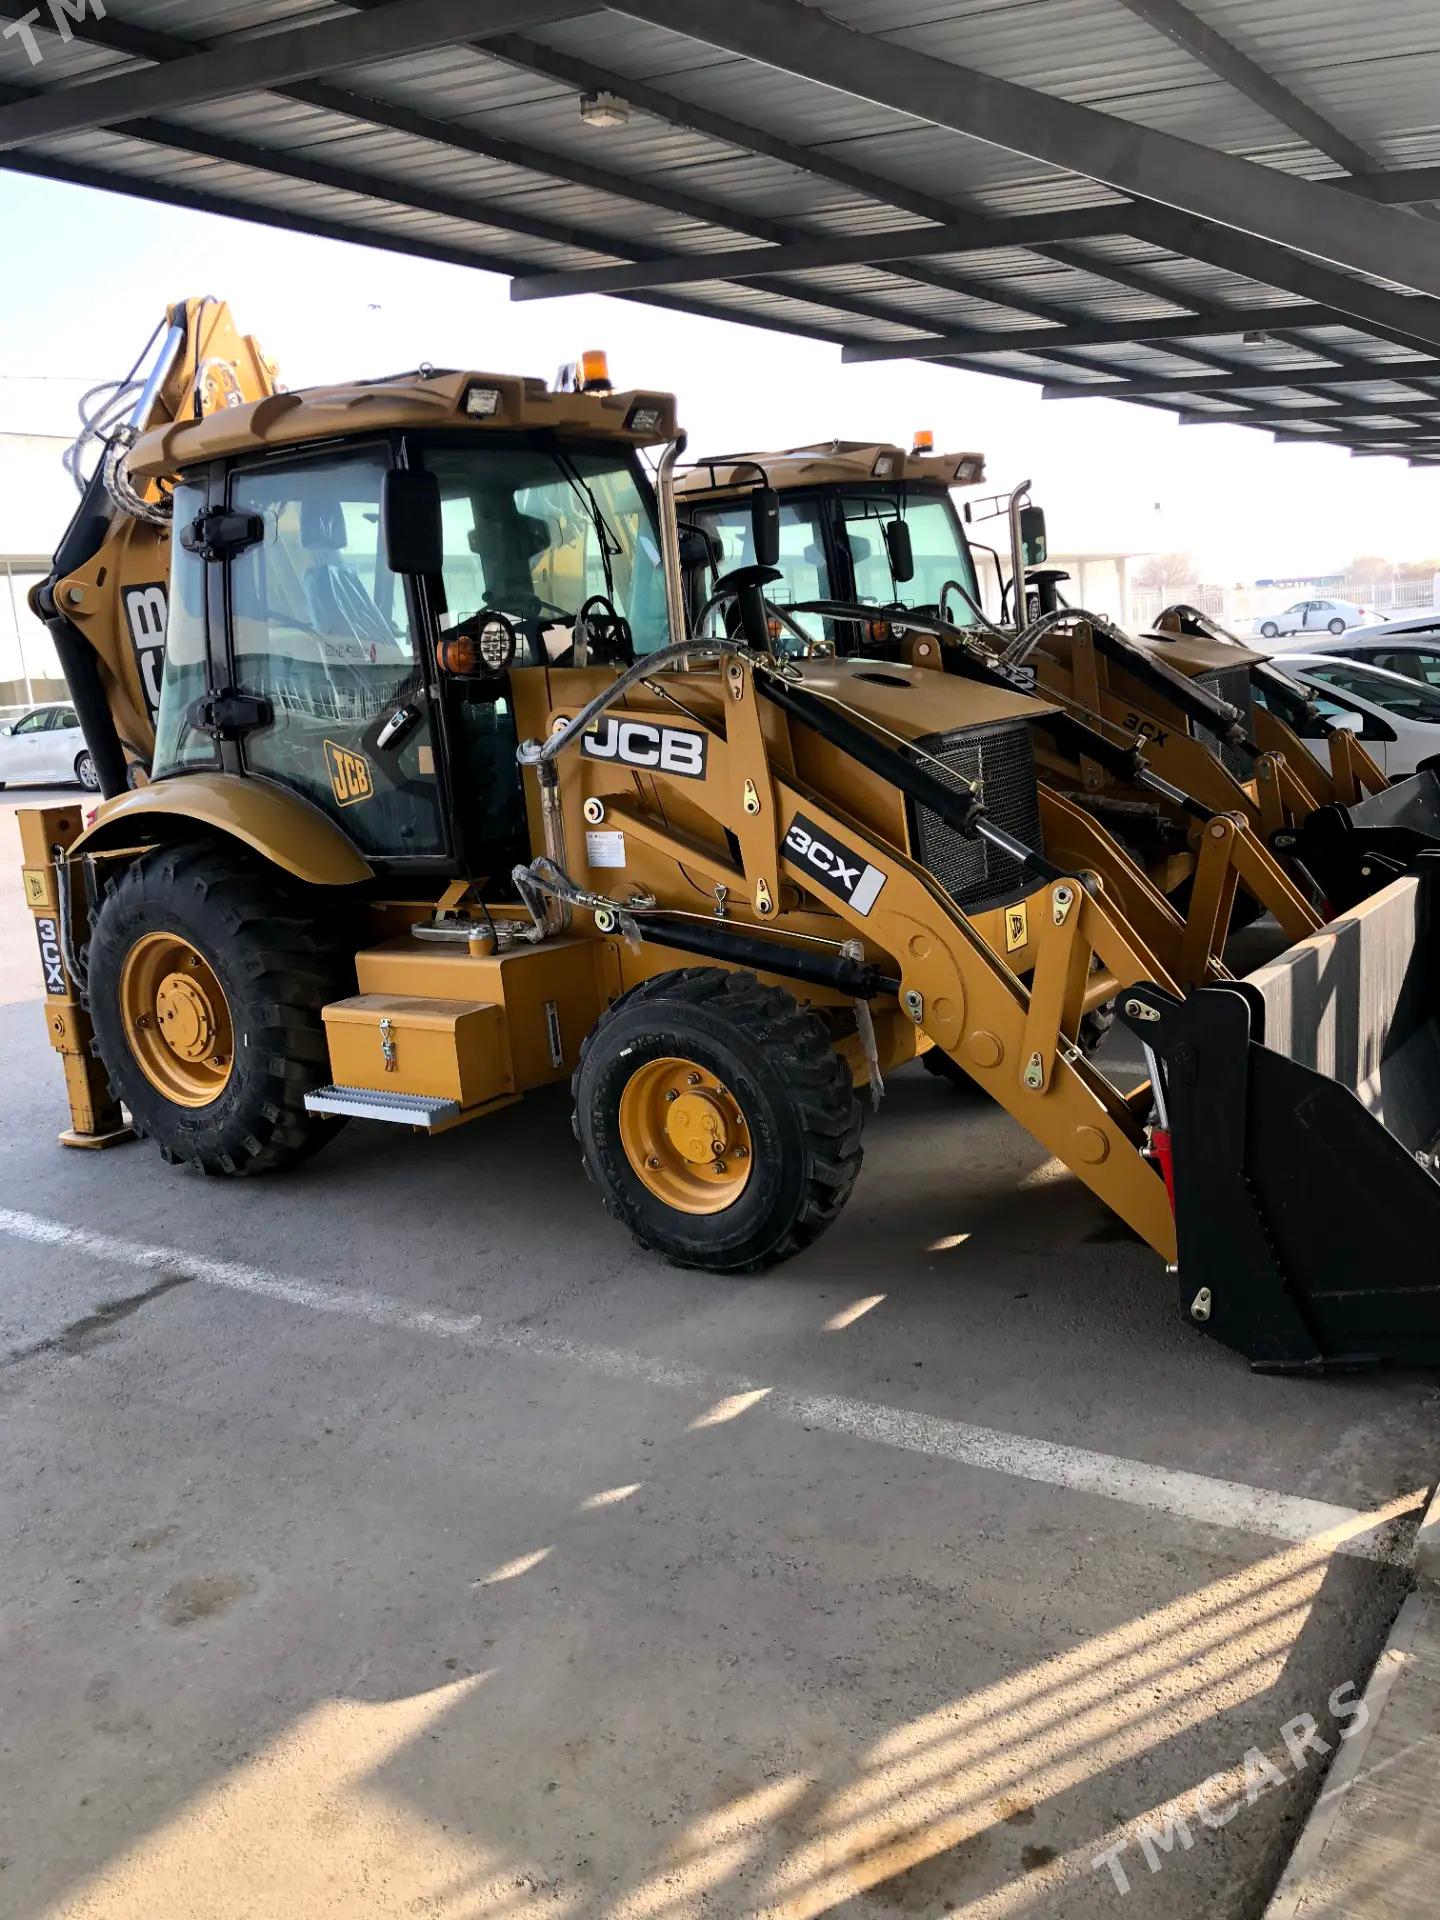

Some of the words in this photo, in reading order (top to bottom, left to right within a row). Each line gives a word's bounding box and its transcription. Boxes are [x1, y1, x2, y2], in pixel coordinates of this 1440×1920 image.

[584, 719, 703, 775] JCB
[1122, 713, 1169, 748] 3CX
[332, 749, 369, 800] JCB
[786, 826, 861, 891] 3CX
[38, 919, 65, 985] 3CX
